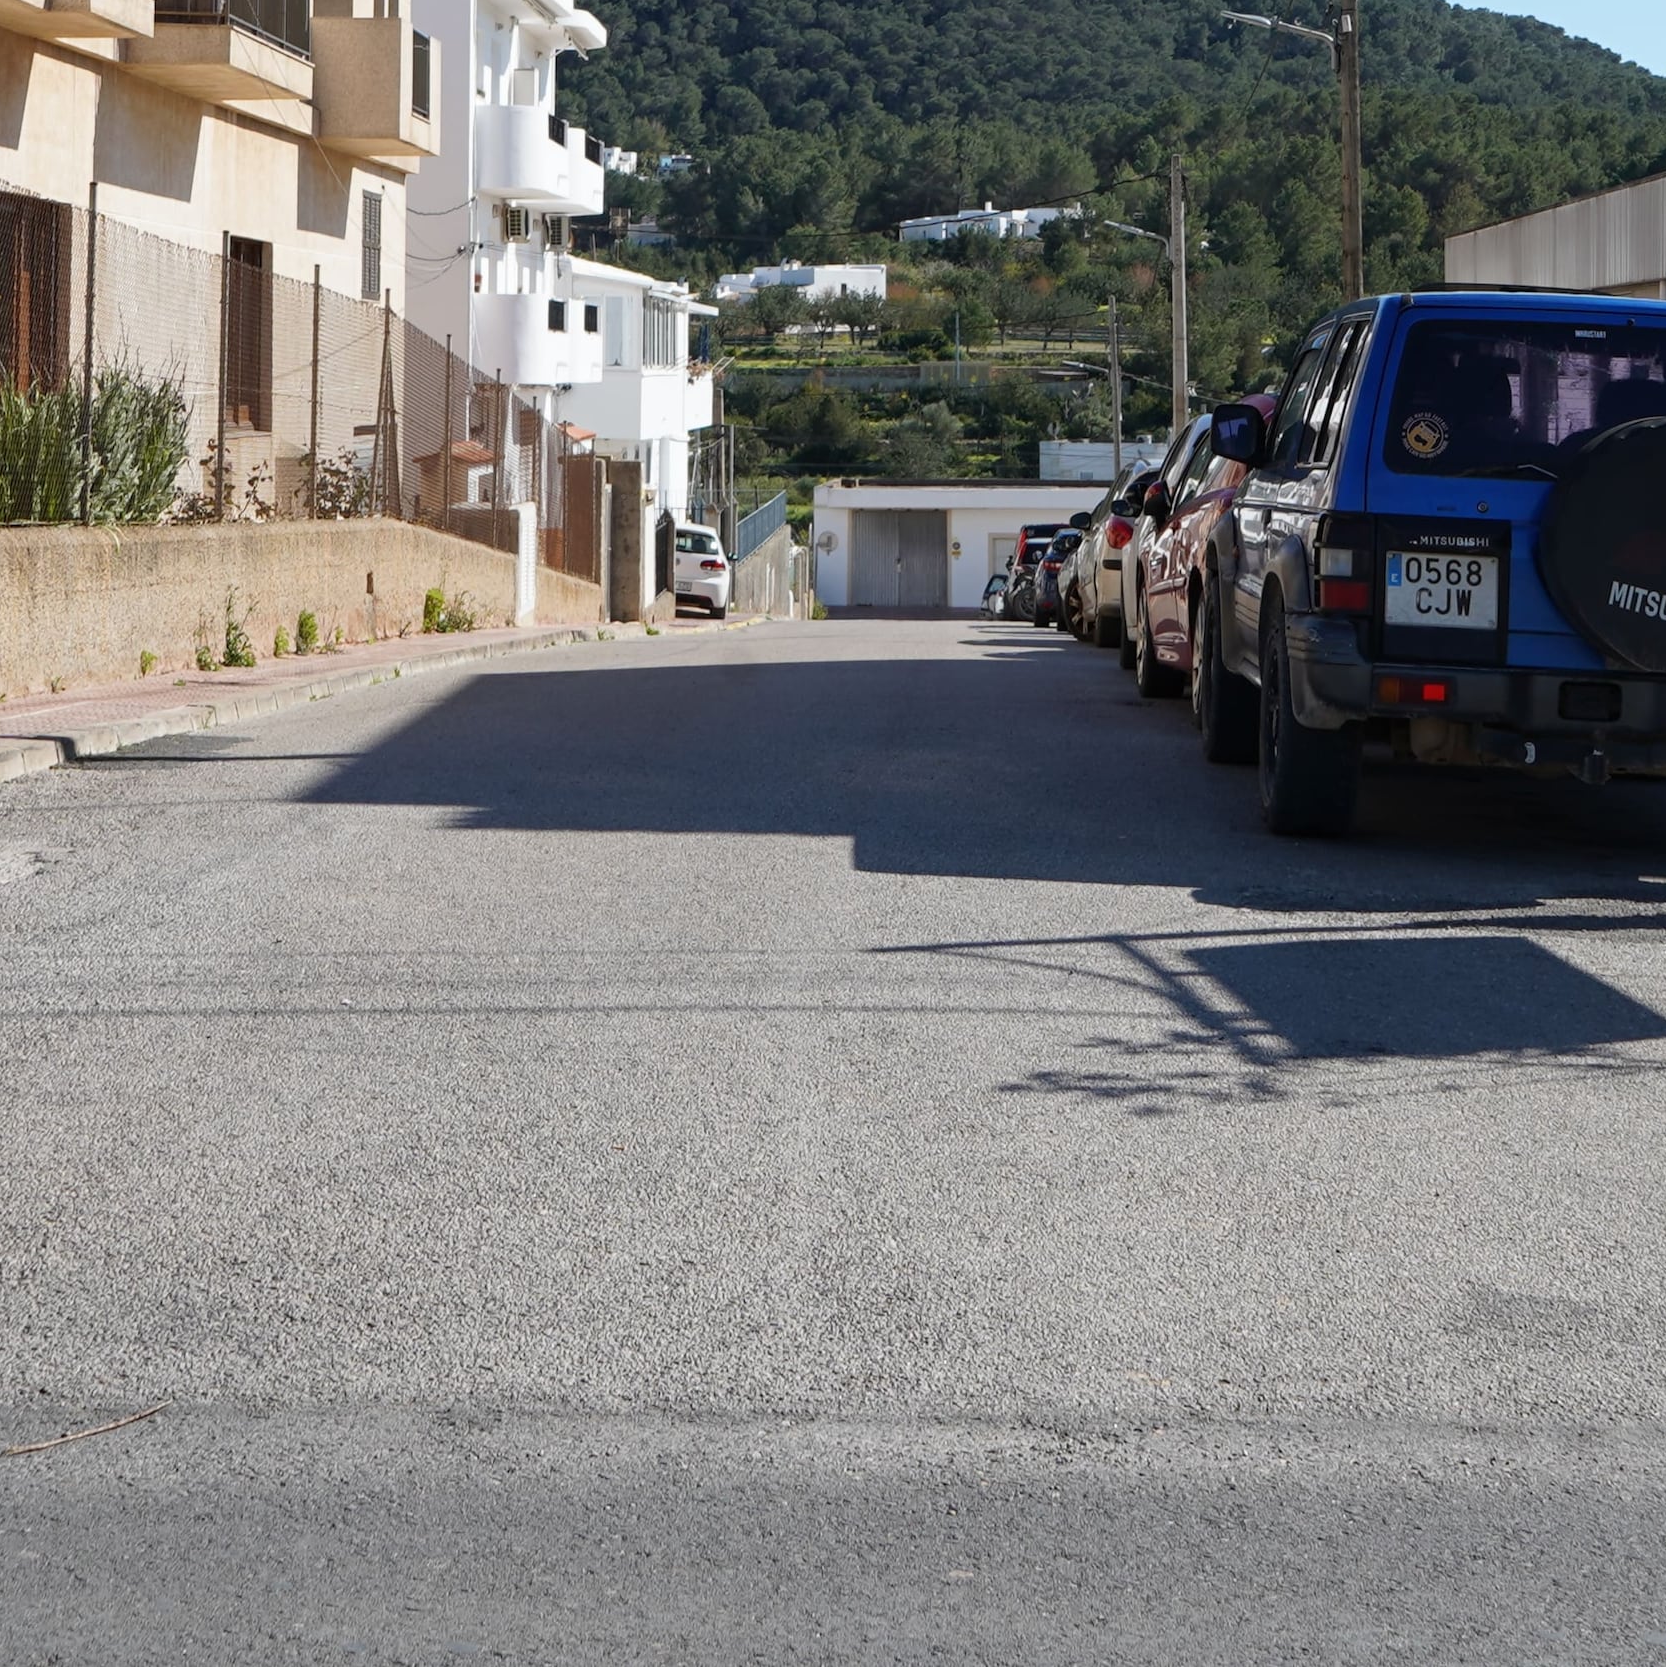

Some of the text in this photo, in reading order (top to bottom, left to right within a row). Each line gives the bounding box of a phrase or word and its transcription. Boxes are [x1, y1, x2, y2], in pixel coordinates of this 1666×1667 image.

[1420, 535, 1490, 547] MITSUBISHI
[1391, 573, 1398, 583] E
[1405, 556, 1482, 586] 0568
[1415, 587, 1472, 616] CJW
